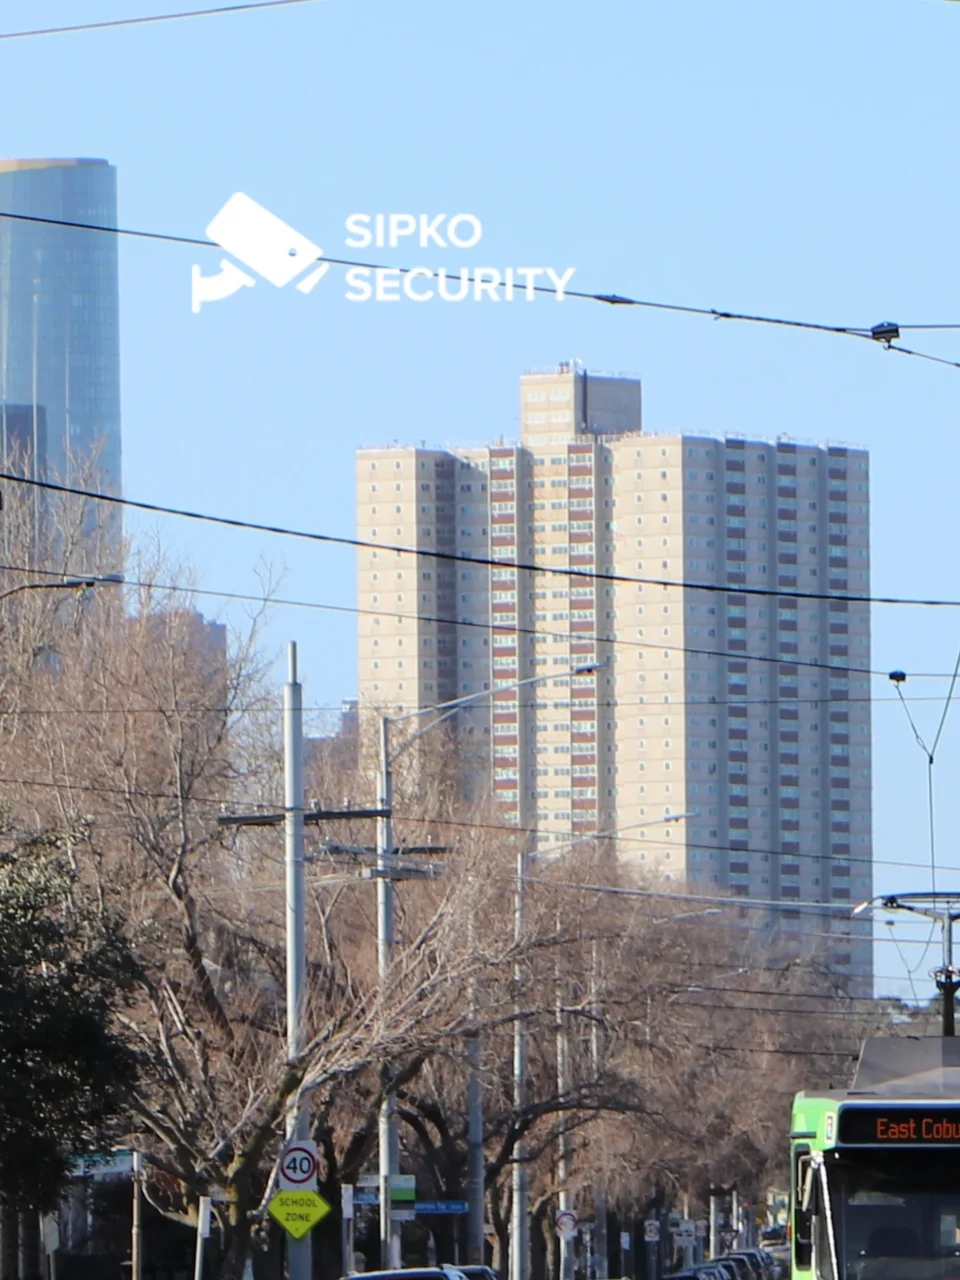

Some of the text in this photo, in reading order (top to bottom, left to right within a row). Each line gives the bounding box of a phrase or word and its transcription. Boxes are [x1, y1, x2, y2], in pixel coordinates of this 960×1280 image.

[876, 1118, 917, 1139] East
[286, 1157, 311, 1174] 40
[279, 1198, 318, 1207] SCHOOL
[285, 1212, 310, 1222] ZONE
